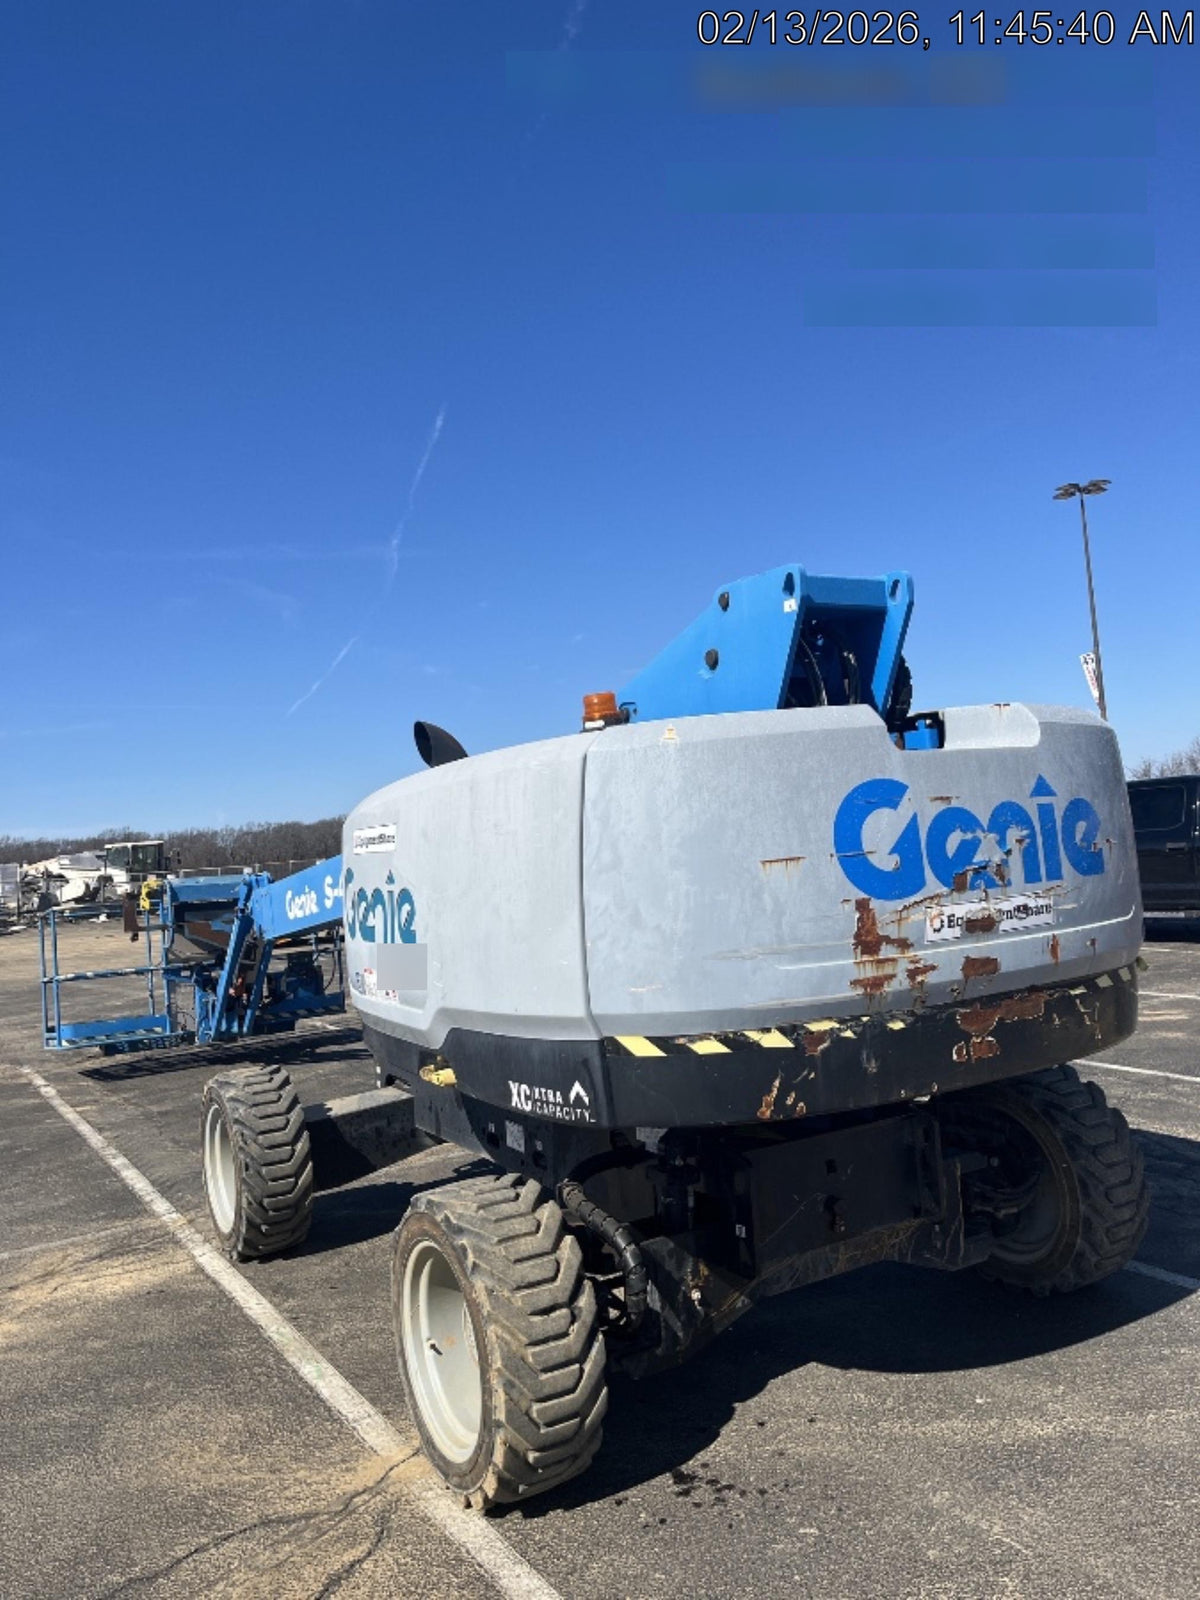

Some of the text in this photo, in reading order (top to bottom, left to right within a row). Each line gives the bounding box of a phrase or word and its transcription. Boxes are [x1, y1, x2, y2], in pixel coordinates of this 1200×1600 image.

[833, 774, 1104, 901] Genie
[285, 885, 319, 920] Genie
[508, 1080, 532, 1112] XC
